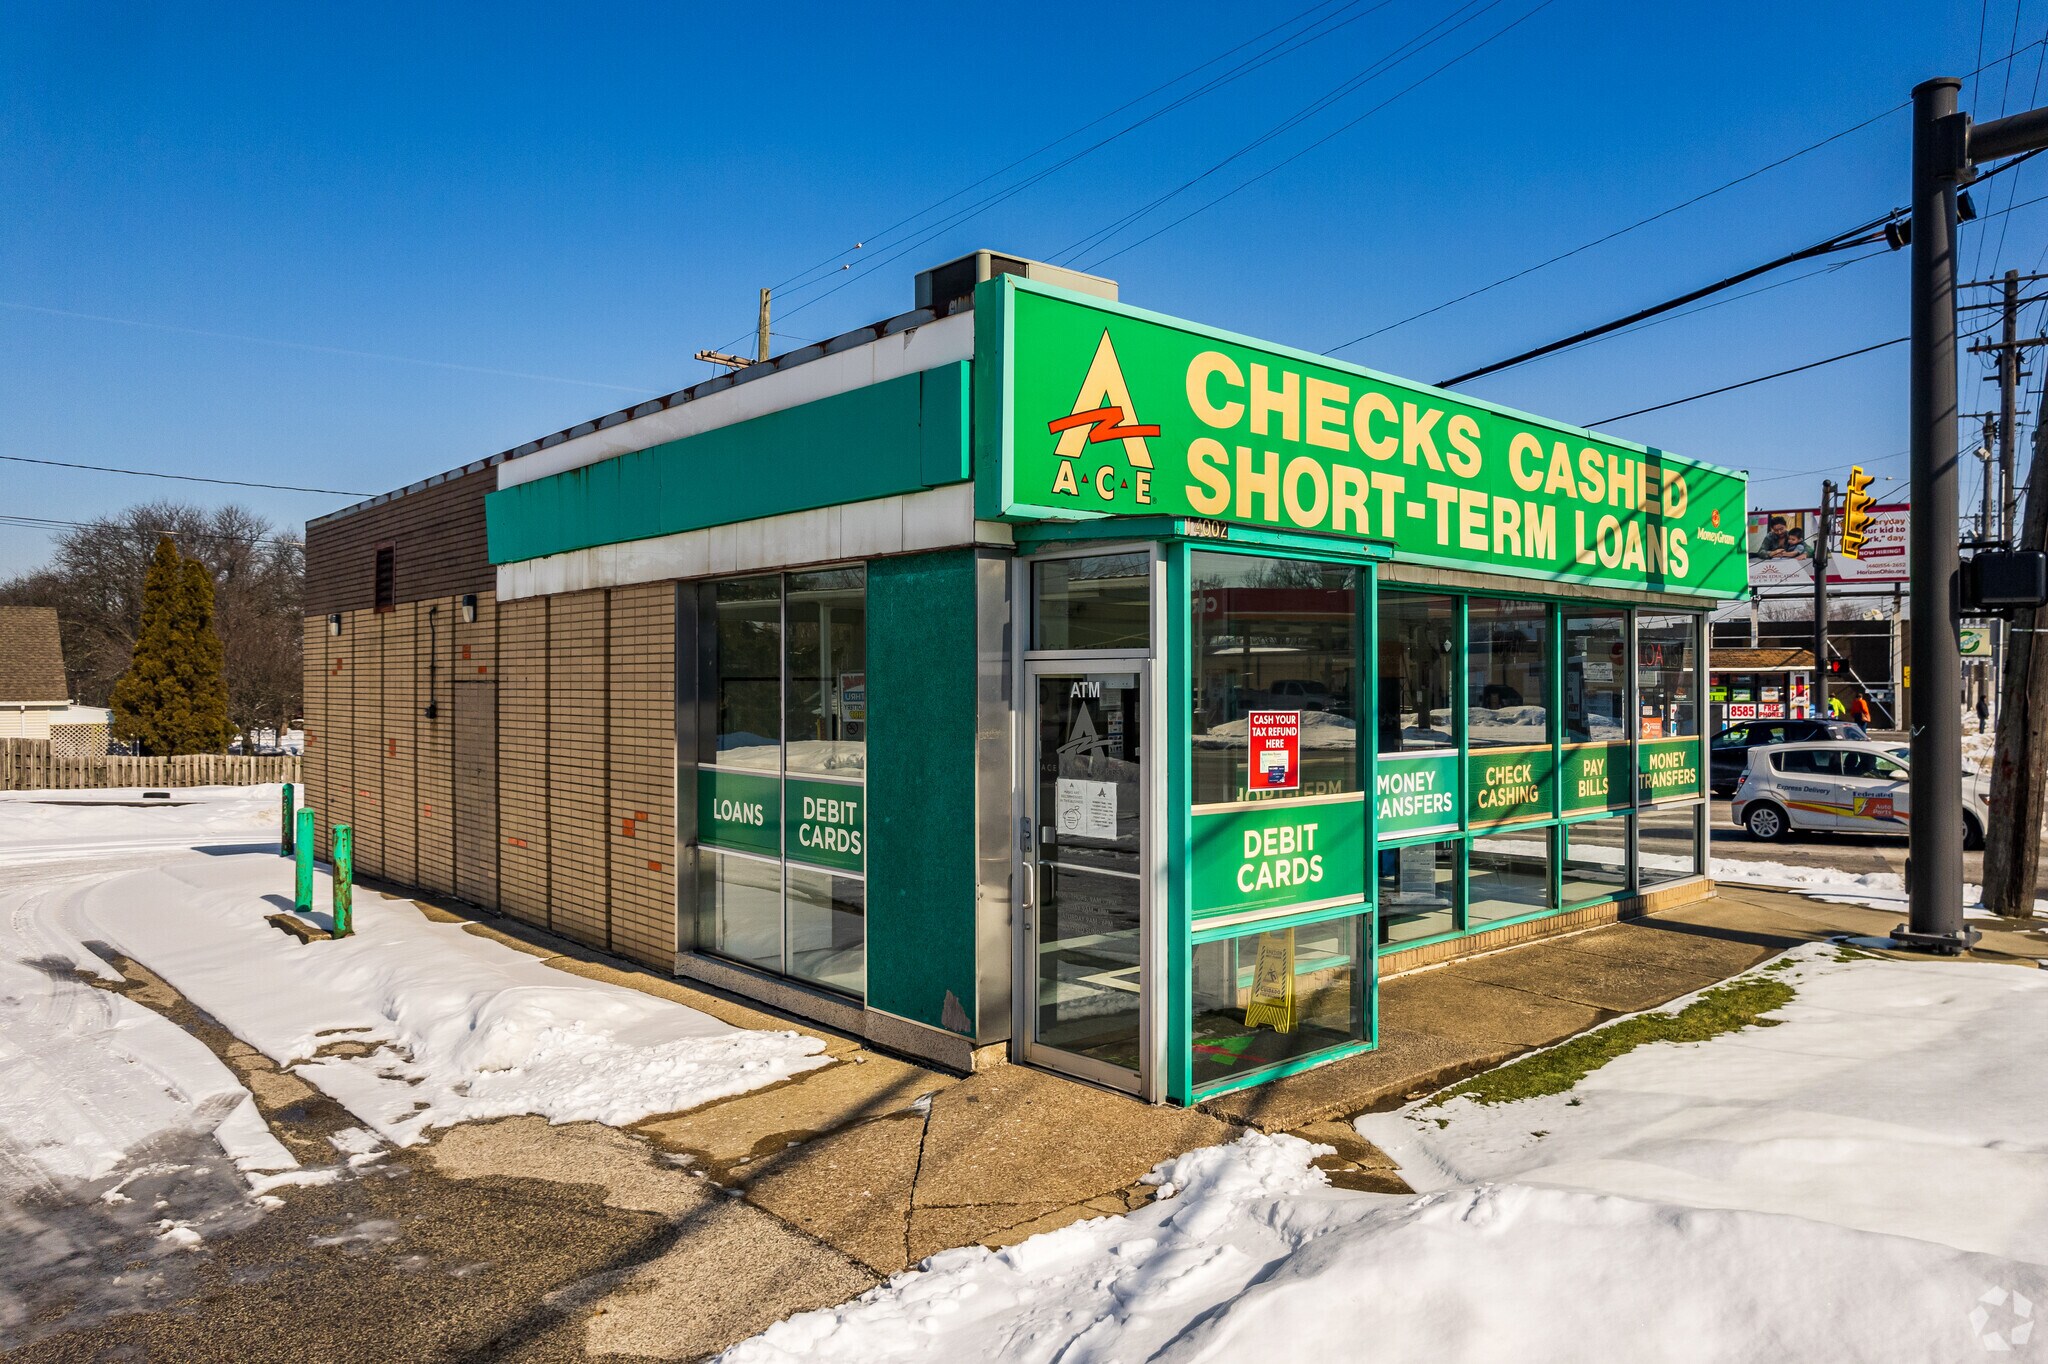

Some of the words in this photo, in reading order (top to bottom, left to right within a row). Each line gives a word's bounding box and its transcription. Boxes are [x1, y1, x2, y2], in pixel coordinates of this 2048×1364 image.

[1186, 351, 1483, 479] CHECKS
[1509, 432, 1689, 519] CASHED
[1185, 437, 1556, 561] SHORT-TERM
[1575, 510, 1690, 579] LOANS
[1697, 526, 1735, 545] MoneyGram
[1070, 681, 1100, 698] ATM
[1253, 715, 1274, 725] CASH
[1275, 715, 1297, 725] YOUR
[1731, 706, 1754, 717] 8585
[1252, 727, 1267, 737] TAX
[1268, 727, 1297, 737] REFUND
[1265, 739, 1285, 749] HERE
[1583, 759, 1604, 776] PAY
[1649, 752, 1686, 770] MONEY
[1377, 770, 1436, 795] MONEY
[1485, 764, 1532, 786] CHECK
[1639, 767, 1696, 790] TRANSFERS
[1477, 784, 1539, 809] CASHING
[1578, 777, 1609, 798] BILLS
[1776, 784, 1802, 793] Express
[1803, 785, 1830, 795] Delivery
[713, 798, 764, 826] LOANS
[804, 797, 857, 826] DEBIT
[1377, 792, 1452, 819] ANSFERS
[799, 823, 862, 855] CARDS
[1244, 823, 1318, 859] DEBIT
[1237, 855, 1324, 893] CARDS
